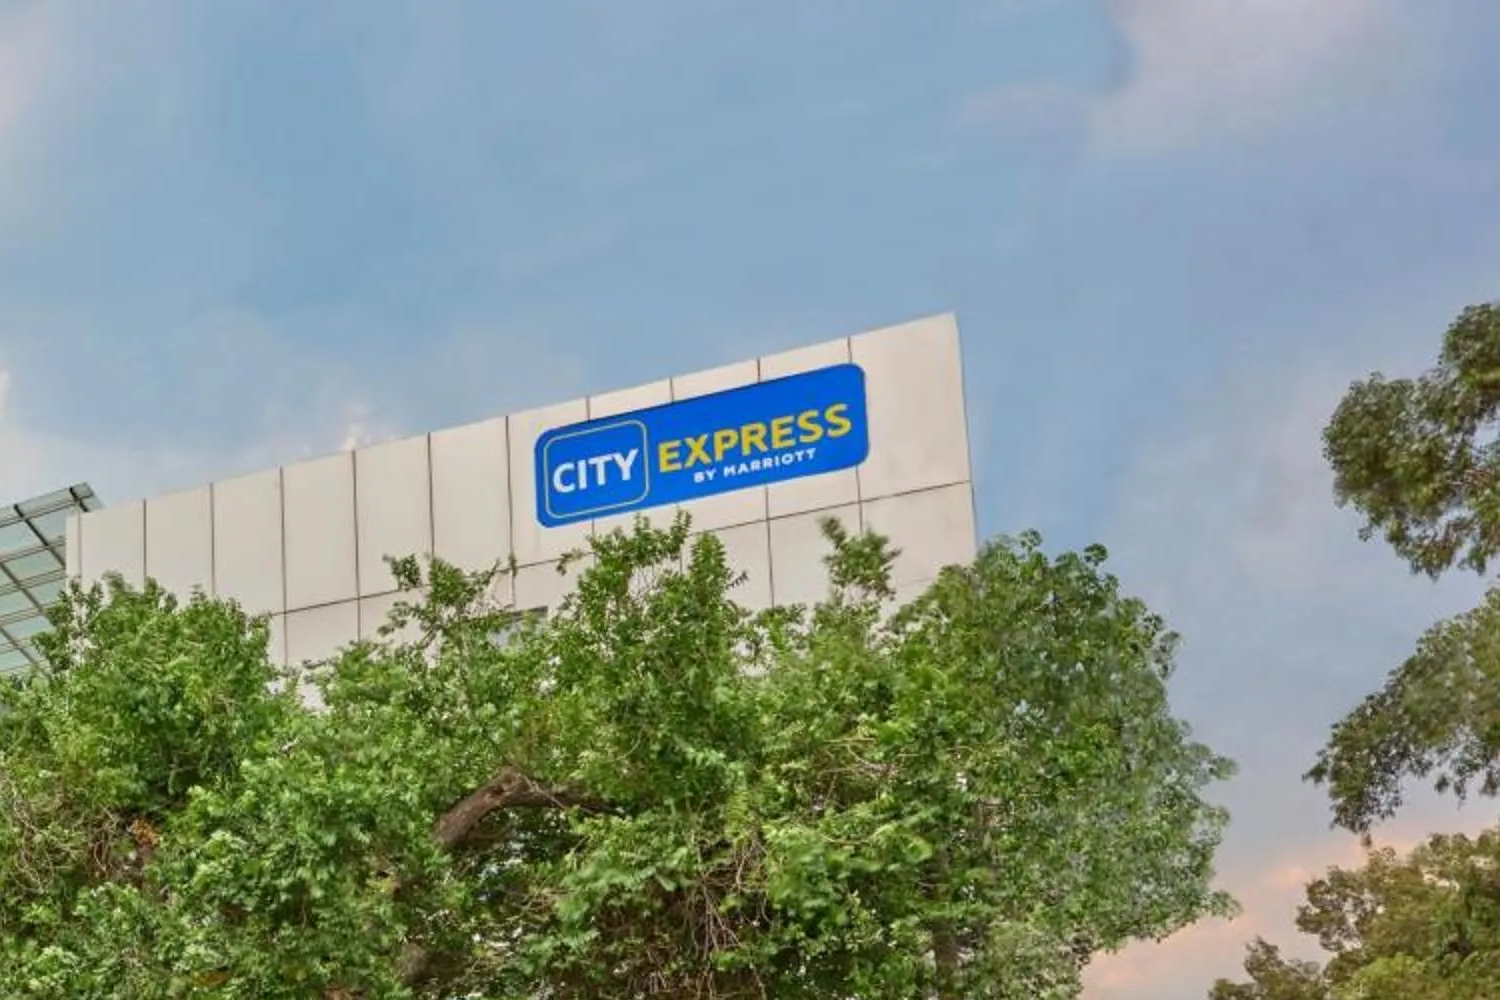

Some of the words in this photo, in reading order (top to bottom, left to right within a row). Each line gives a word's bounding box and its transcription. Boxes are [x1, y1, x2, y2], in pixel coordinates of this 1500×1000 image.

[553, 447, 639, 493] CITY
[657, 403, 853, 473] EXPRESS
[693, 468, 717, 484] BY
[723, 447, 817, 478] MARRIOTT
